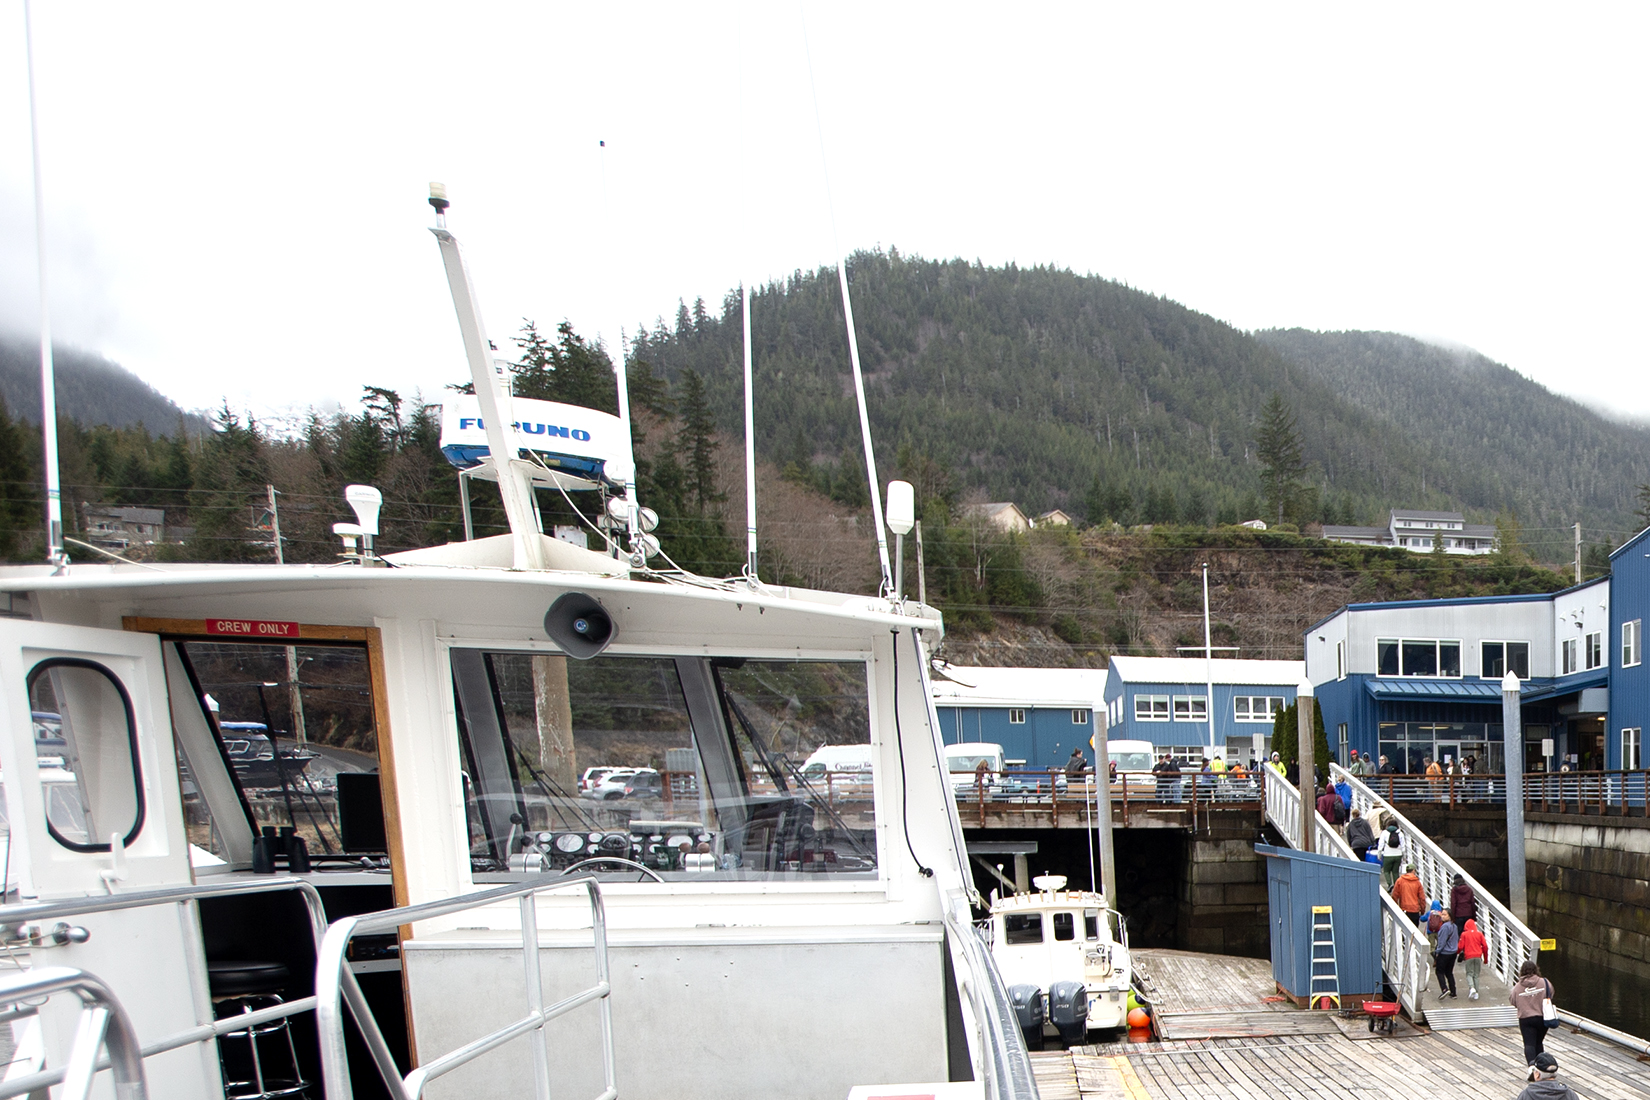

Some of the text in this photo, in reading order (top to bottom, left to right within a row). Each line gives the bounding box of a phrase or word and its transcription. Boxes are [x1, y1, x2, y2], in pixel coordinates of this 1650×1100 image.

[459, 418, 592, 442] FUNO
[216, 621, 289, 634] CREW ONLY
